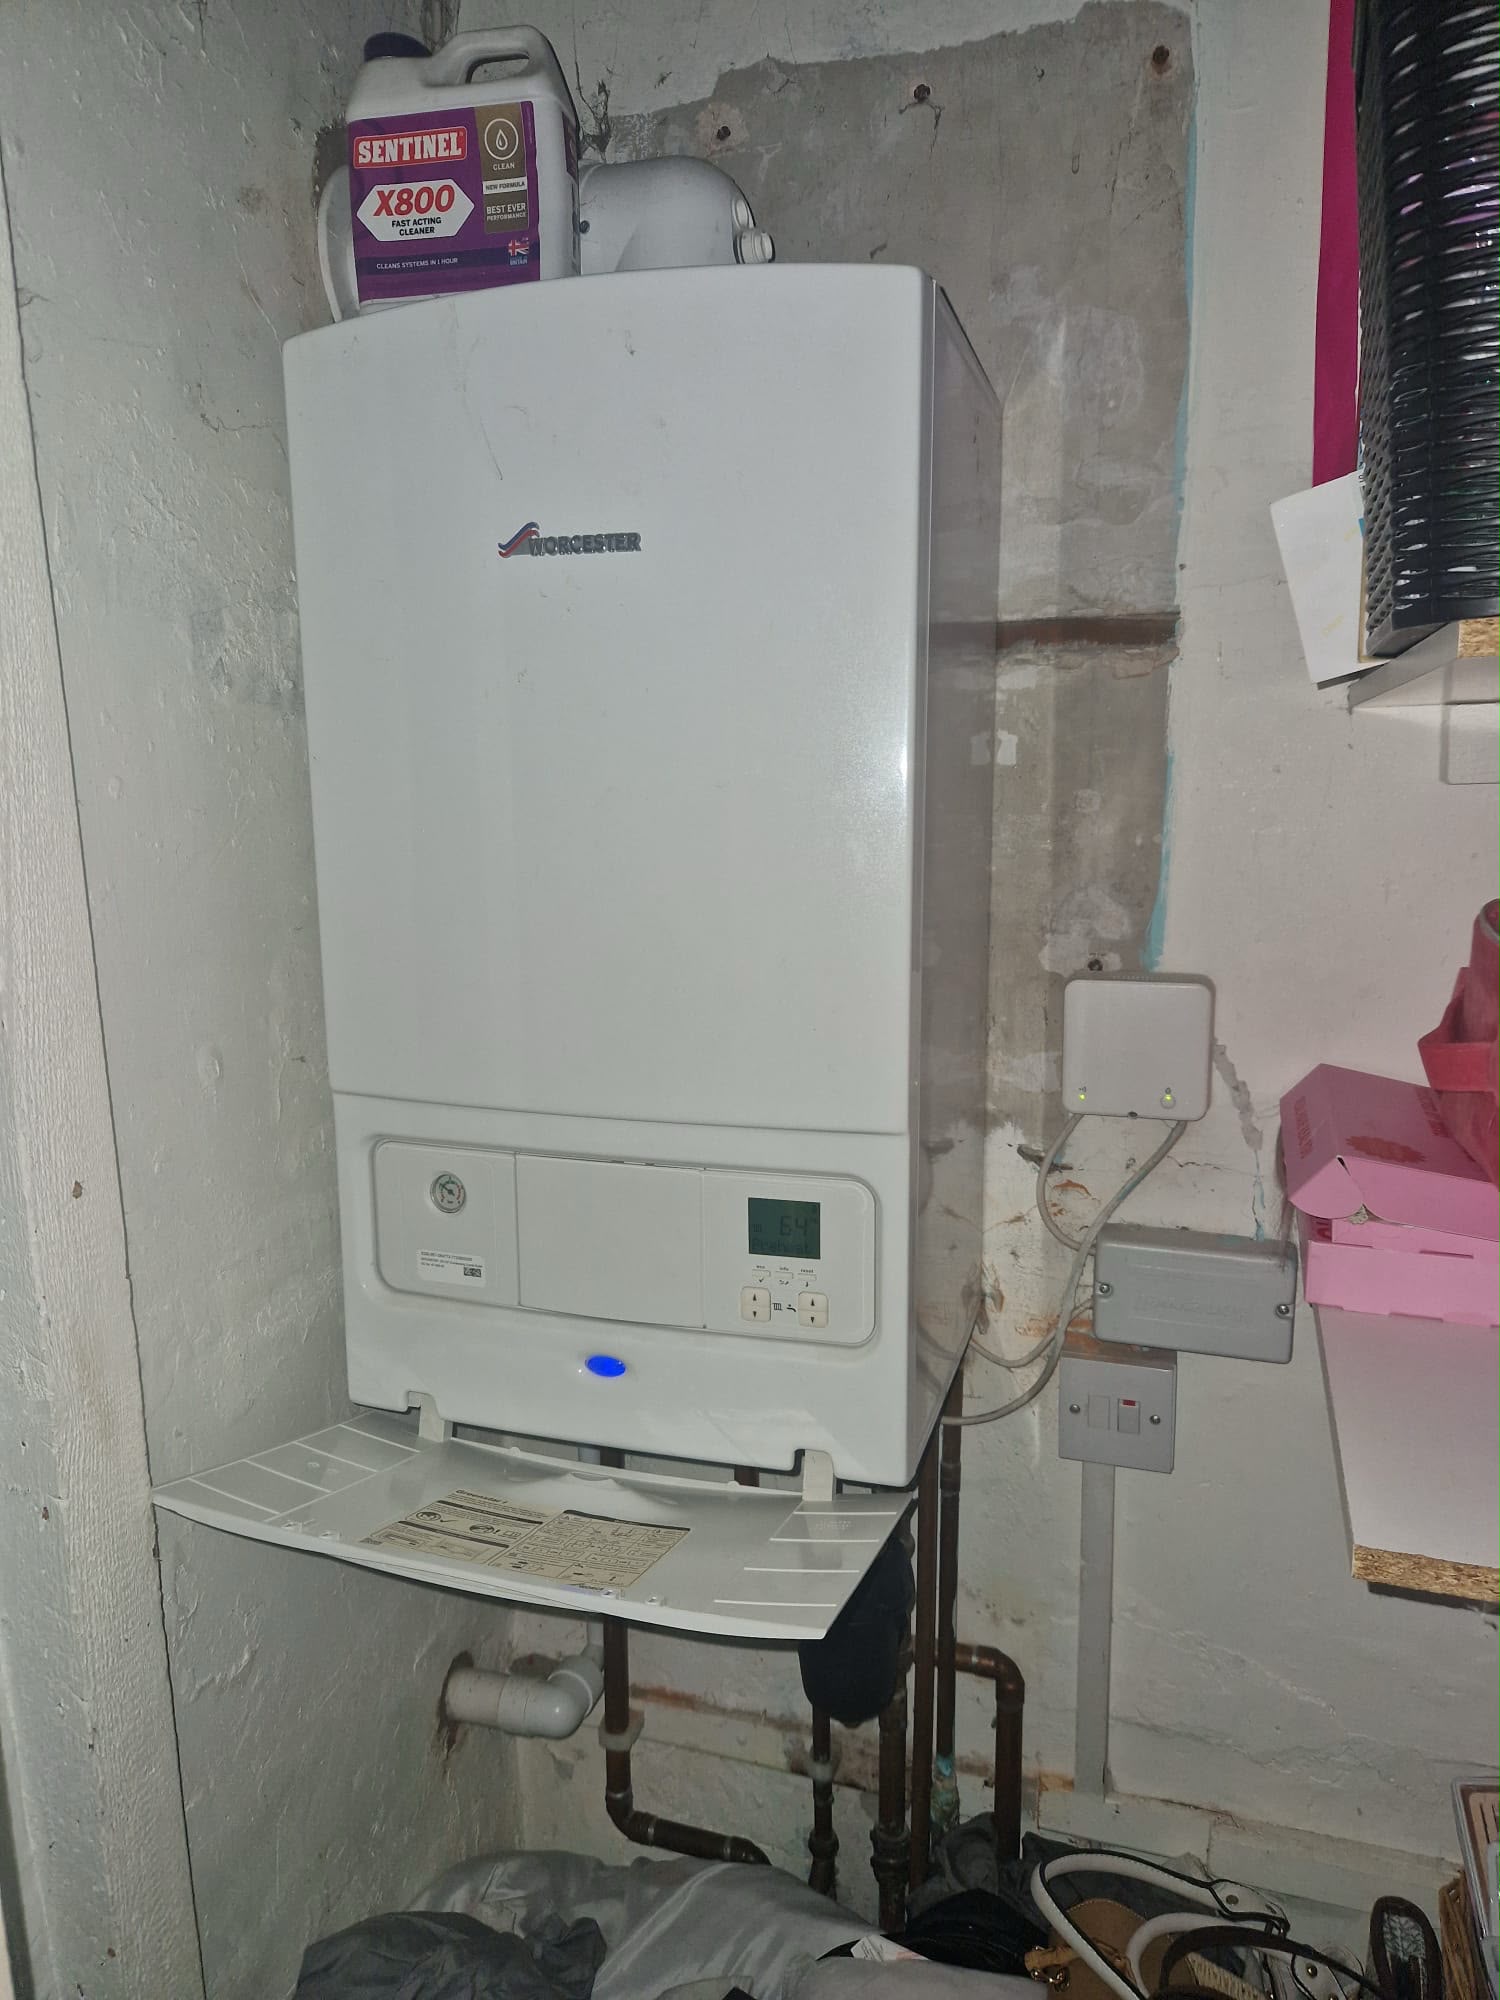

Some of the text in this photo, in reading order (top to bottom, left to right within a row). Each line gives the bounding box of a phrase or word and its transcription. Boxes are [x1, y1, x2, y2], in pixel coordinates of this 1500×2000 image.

[358, 131, 462, 164] SENTINEL
[492, 162, 515, 171] CLEAN
[485, 181, 526, 191] NEW FORMULA
[373, 184, 456, 217] X800
[486, 203, 526, 214] BEST EVER
[486, 212, 526, 221] PERFORMANCE
[391, 217, 442, 228] FAST ACTING
[399, 227, 435, 236] CLEANER
[401, 260, 429, 268] SYSTEMS
[441, 257, 458, 265] HOUR
[529, 532, 642, 556] WORCESTER
